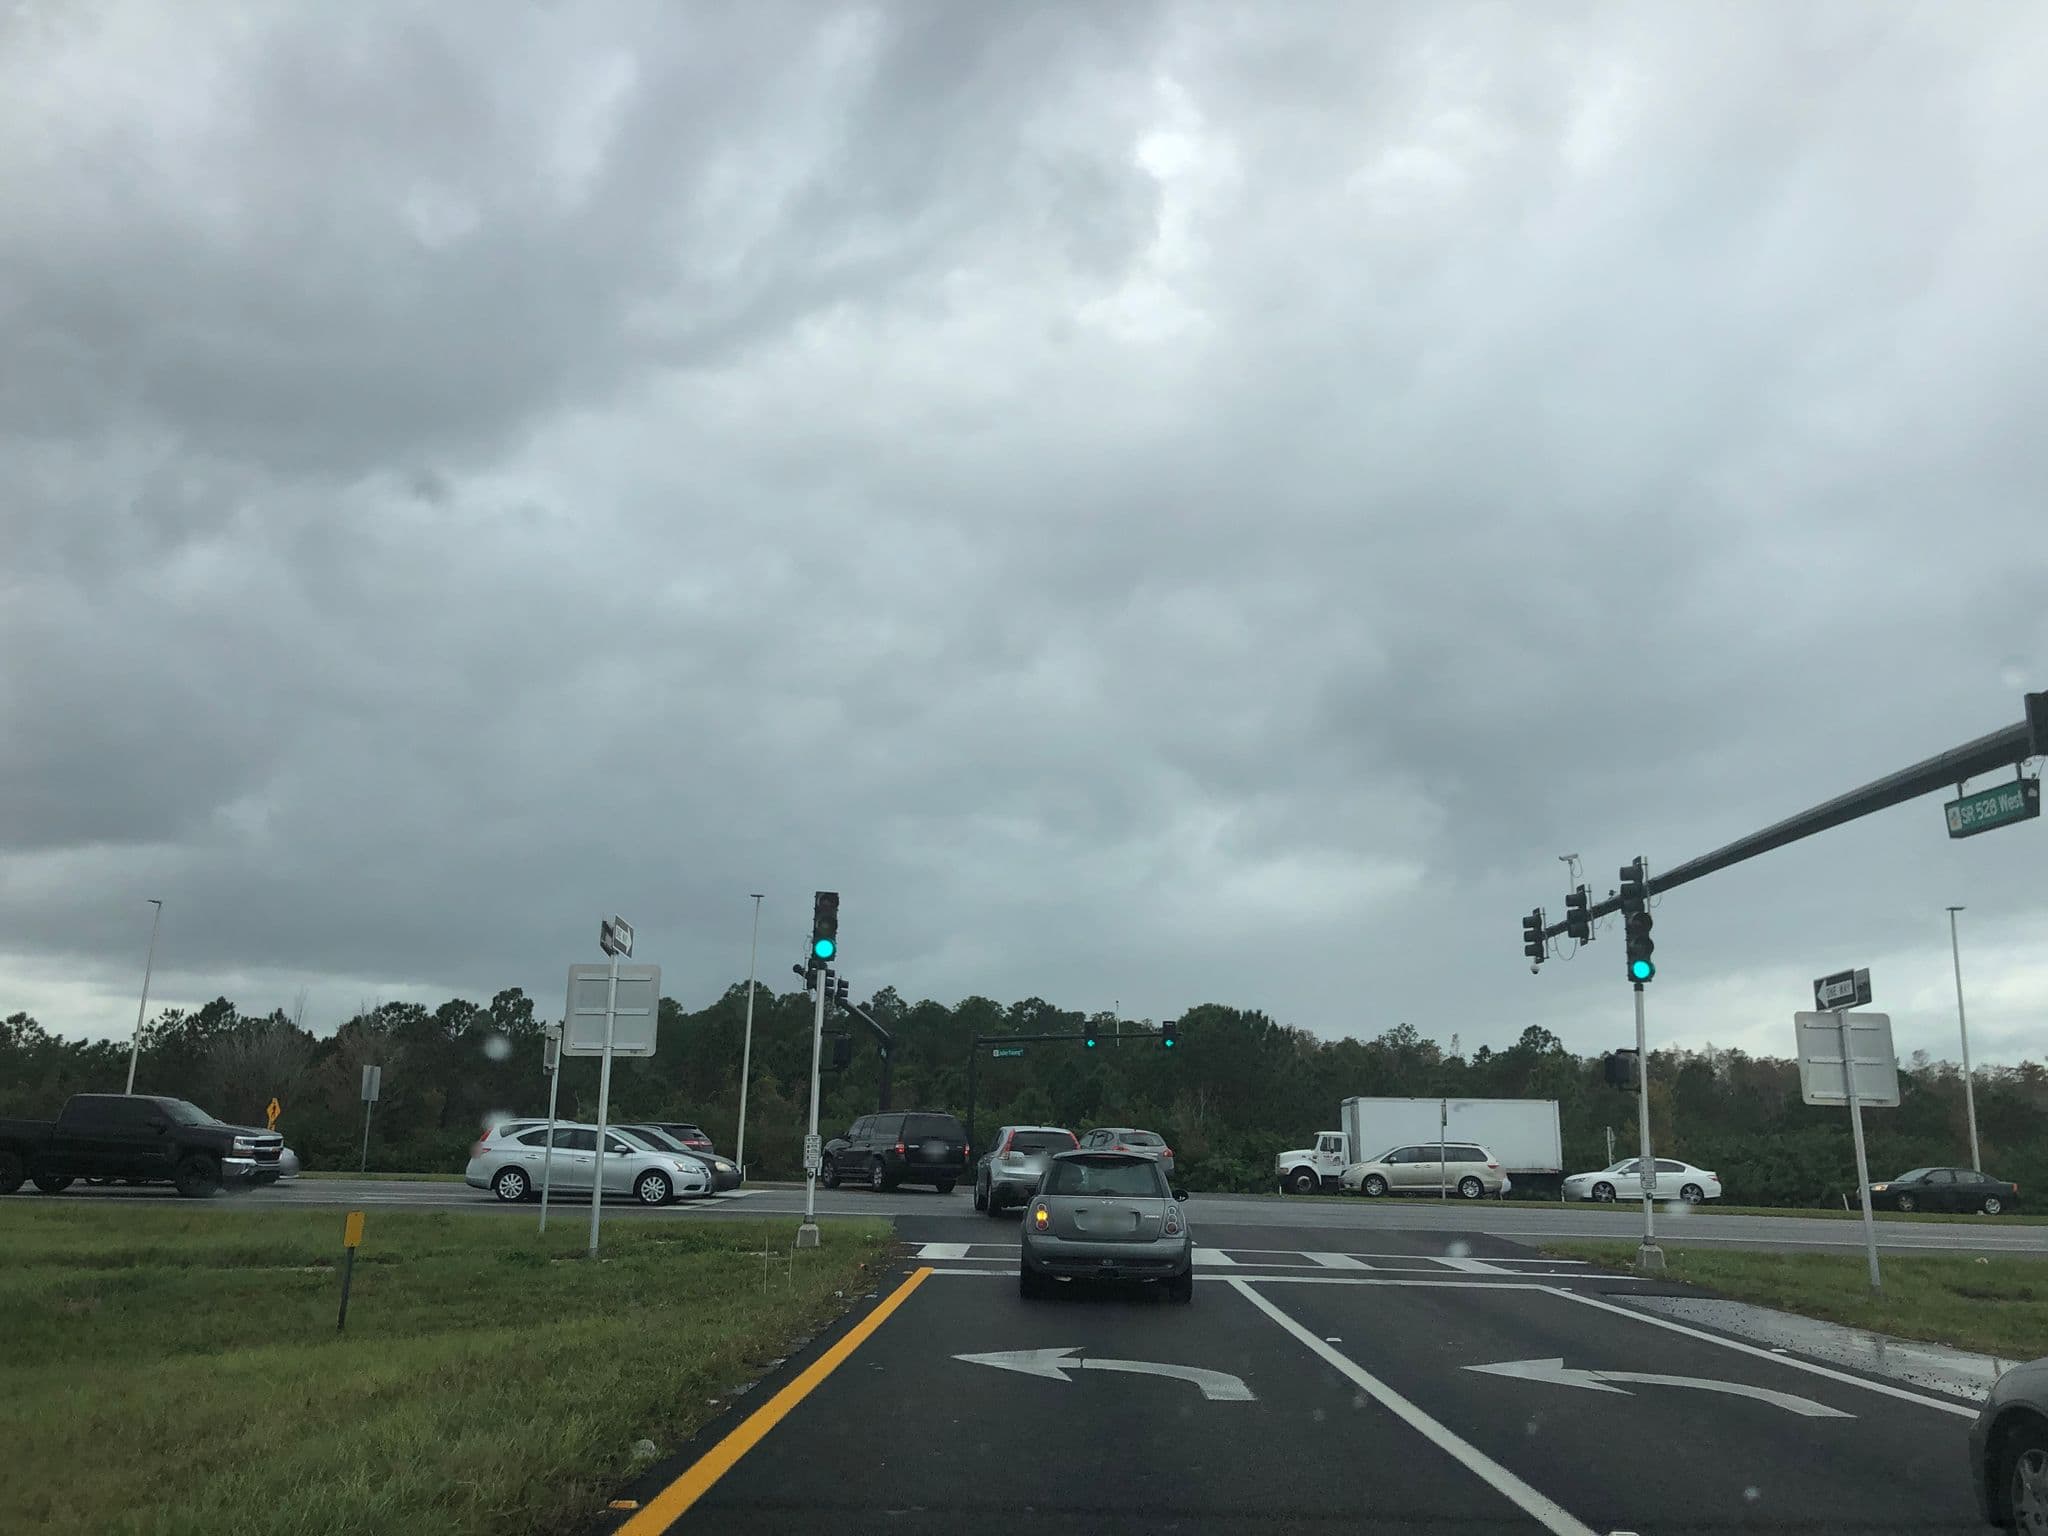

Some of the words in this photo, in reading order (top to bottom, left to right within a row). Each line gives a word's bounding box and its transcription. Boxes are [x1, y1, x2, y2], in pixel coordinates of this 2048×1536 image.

[1961, 805, 1975, 824] SR
[1976, 798, 1998, 820] 528
[1999, 790, 2024, 812] West
